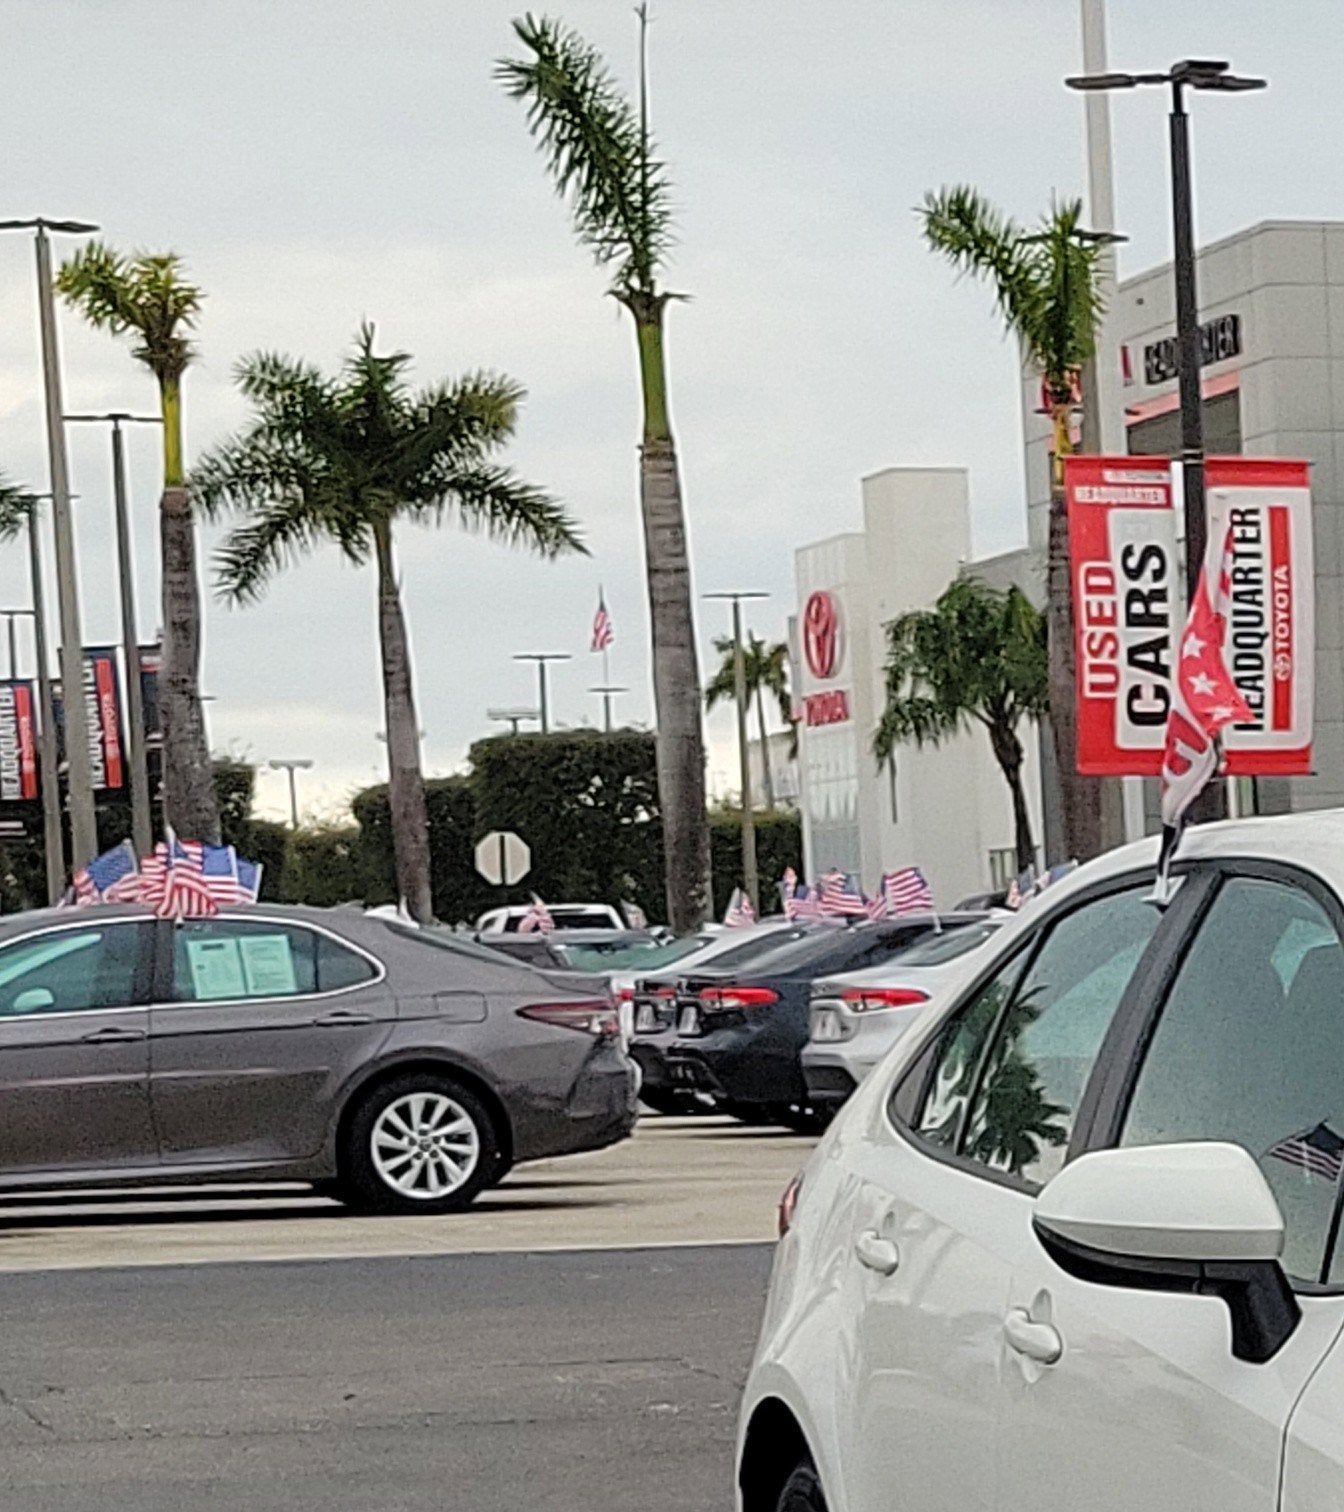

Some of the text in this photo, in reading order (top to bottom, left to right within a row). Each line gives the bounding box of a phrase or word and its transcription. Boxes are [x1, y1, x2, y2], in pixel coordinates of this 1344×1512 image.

[1084, 543, 1171, 727] USED CARS
[1273, 564, 1290, 648] TOYOTA
